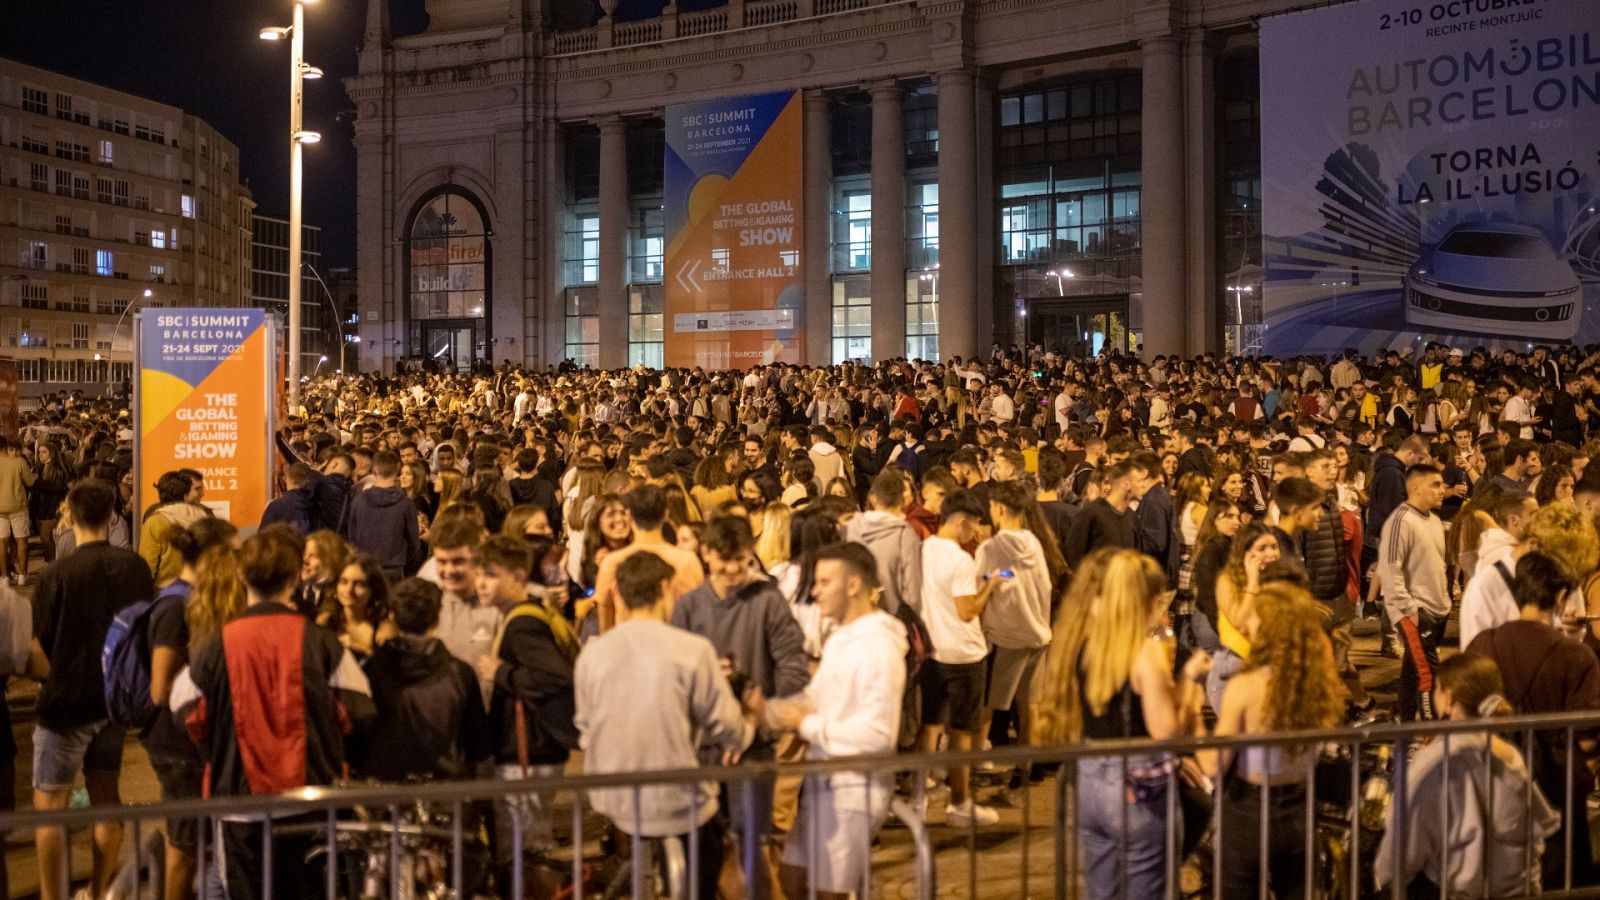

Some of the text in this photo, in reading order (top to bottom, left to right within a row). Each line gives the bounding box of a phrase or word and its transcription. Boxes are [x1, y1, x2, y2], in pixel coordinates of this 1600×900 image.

[1380, 0, 1535, 30] 2-10 OCTUB
[1426, 21, 1476, 37] RECINTE
[1348, 72, 1600, 136] BARCELON
[682, 108, 756, 127] SBC SUMMIT
[687, 124, 751, 138] BARCELONA
[704, 139, 736, 149] SEPTEMBER
[1430, 142, 1541, 174] TORNA
[1398, 182, 1434, 205] LA
[720, 199, 794, 217] THE GLOBAL
[740, 226, 794, 247] SHOW
[703, 267, 794, 281] ENTRANCE HALL 2
[157, 316, 250, 327] SBC SUMMIT
[163, 330, 243, 339] BARCELONA
[162, 344, 245, 353] 21-24 SEPT 2021
[204, 393, 238, 407] THE
[176, 408, 238, 421] GLOBAL
[189, 422, 238, 431] BETTING
[174, 443, 238, 460] SHOW
[203, 480, 238, 490] LL 2
